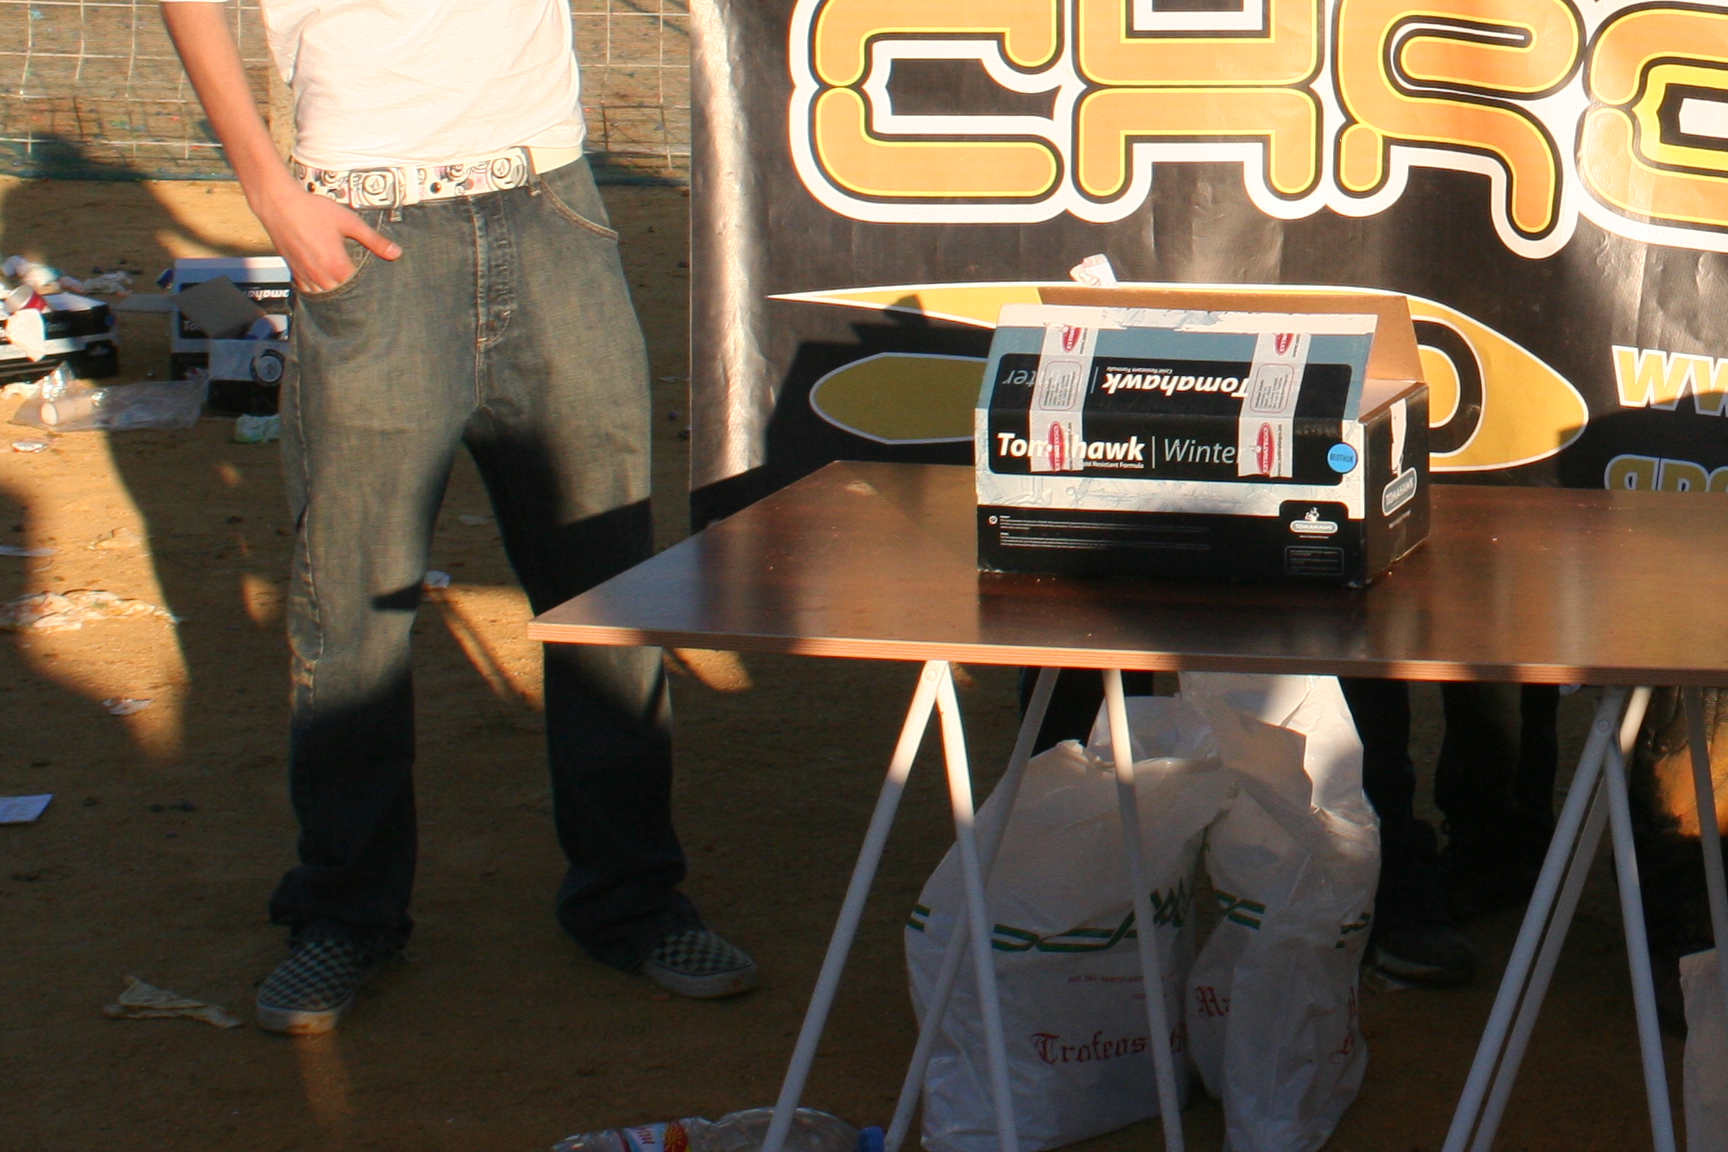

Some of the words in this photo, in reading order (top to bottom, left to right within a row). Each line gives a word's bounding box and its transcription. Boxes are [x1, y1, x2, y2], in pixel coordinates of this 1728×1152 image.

[1101, 372, 1254, 399] Tomahawk
[997, 432, 1146, 462] Tomhawk
[1164, 438, 1239, 465] Winte
[1031, 1030, 1148, 1065] Trofeos
